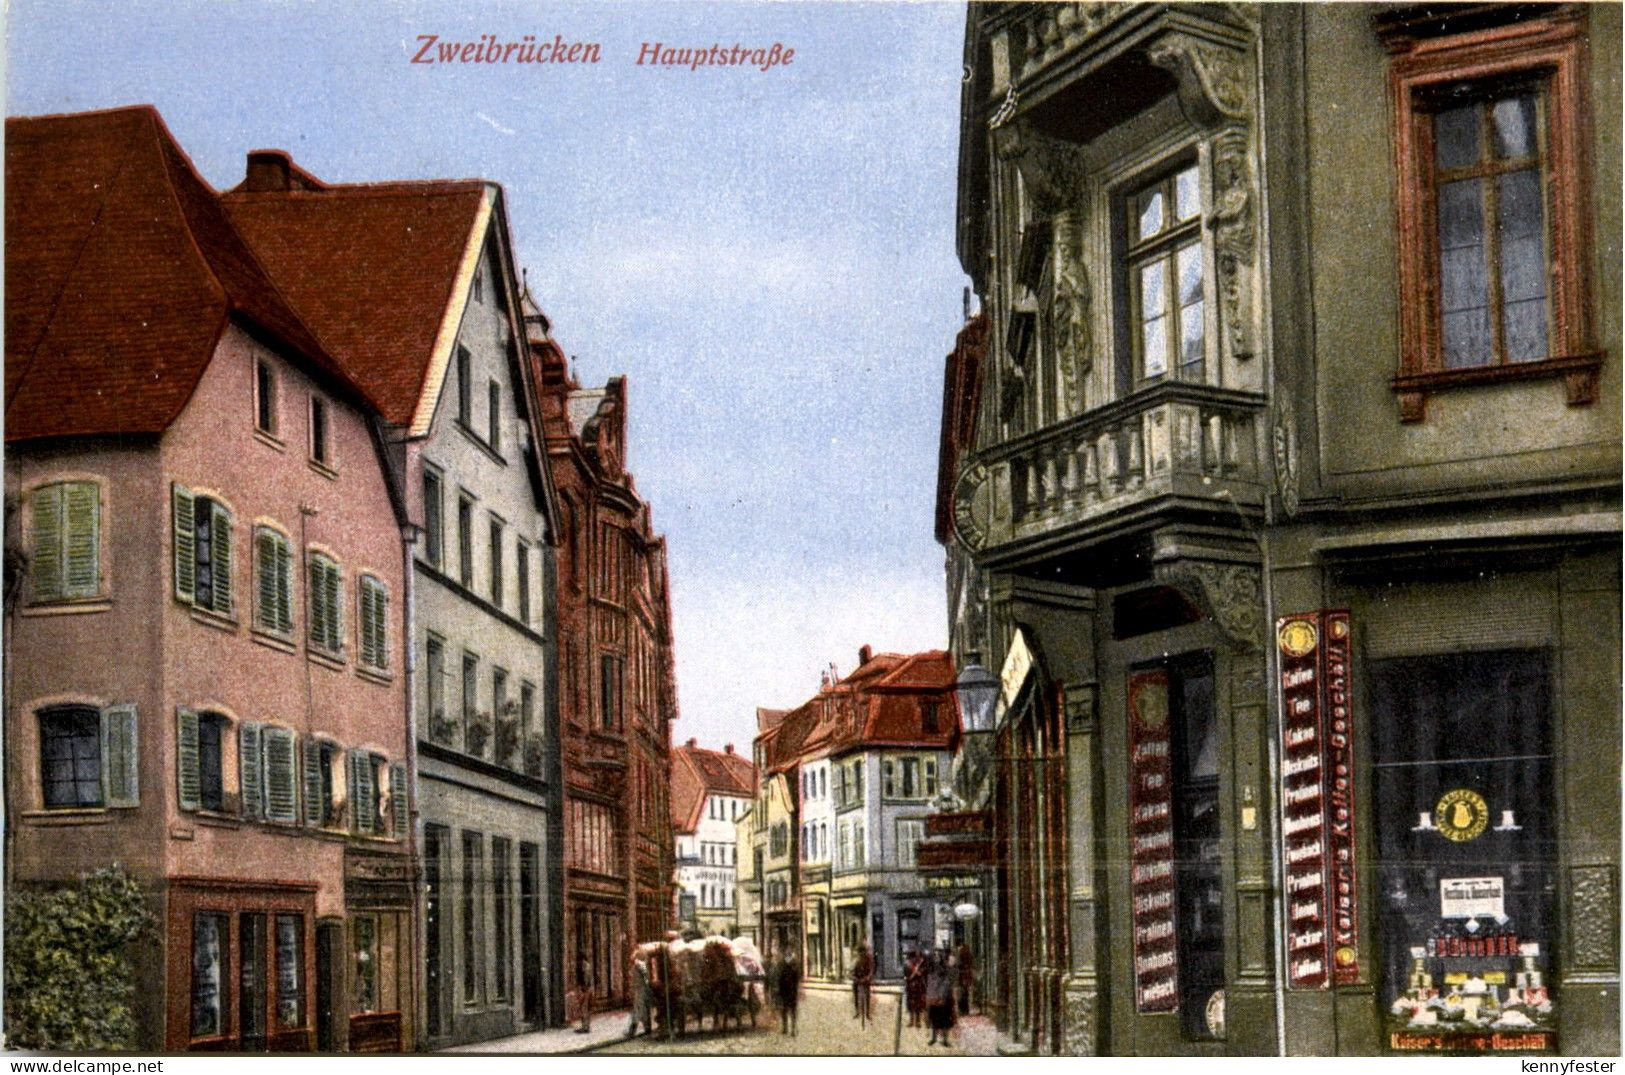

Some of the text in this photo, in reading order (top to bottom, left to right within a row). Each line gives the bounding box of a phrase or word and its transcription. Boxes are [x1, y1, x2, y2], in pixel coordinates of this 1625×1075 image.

[1287, 697, 1311, 717] Tee
[1142, 772, 1163, 791] Tee
[1329, 647, 1351, 944] Kaiser's Kaffee-Geschäft
